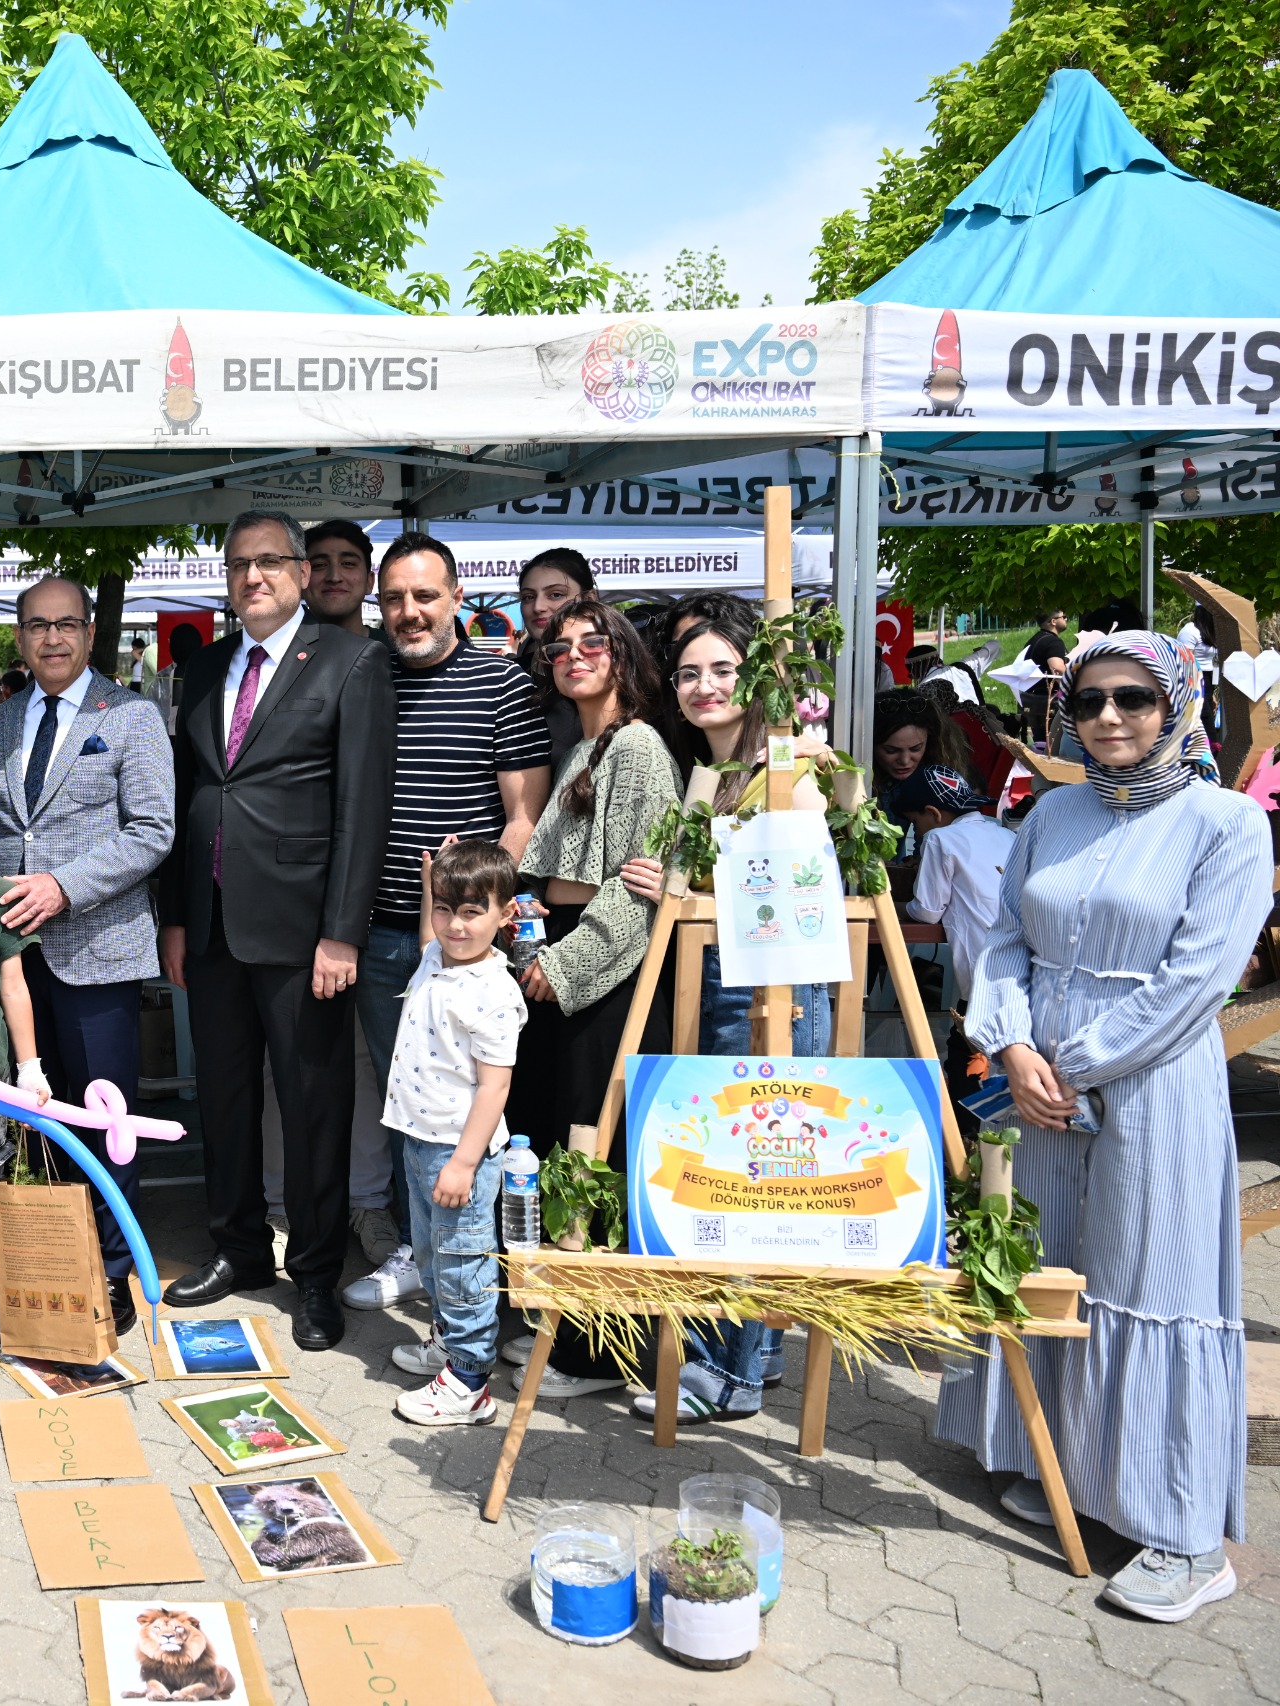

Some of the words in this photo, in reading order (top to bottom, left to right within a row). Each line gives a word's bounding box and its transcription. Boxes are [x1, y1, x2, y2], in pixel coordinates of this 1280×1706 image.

[778, 323, 818, 338] 2023
[692, 323, 818, 378] EXPO
[692, 406, 817, 418] KAHRAMANMARAŞ
[645, 551, 738, 574] BELEDİYESİ
[750, 1081, 814, 1099] ATÖLYE
[747, 1137, 816, 1159] ÇOCUK
[682, 1171, 738, 1192] RECYCLE
[742, 1185, 763, 1196] and
[766, 1186, 808, 1197] SPEAK
[811, 1176, 884, 1196] WORKSHOP
[710, 1192, 785, 1211] (DÖNÜŞTÜR
[806, 1196, 856, 1210] KONUŞ)
[37, 1406, 79, 1476] MOUSE
[73, 1500, 126, 1571] BEAR
